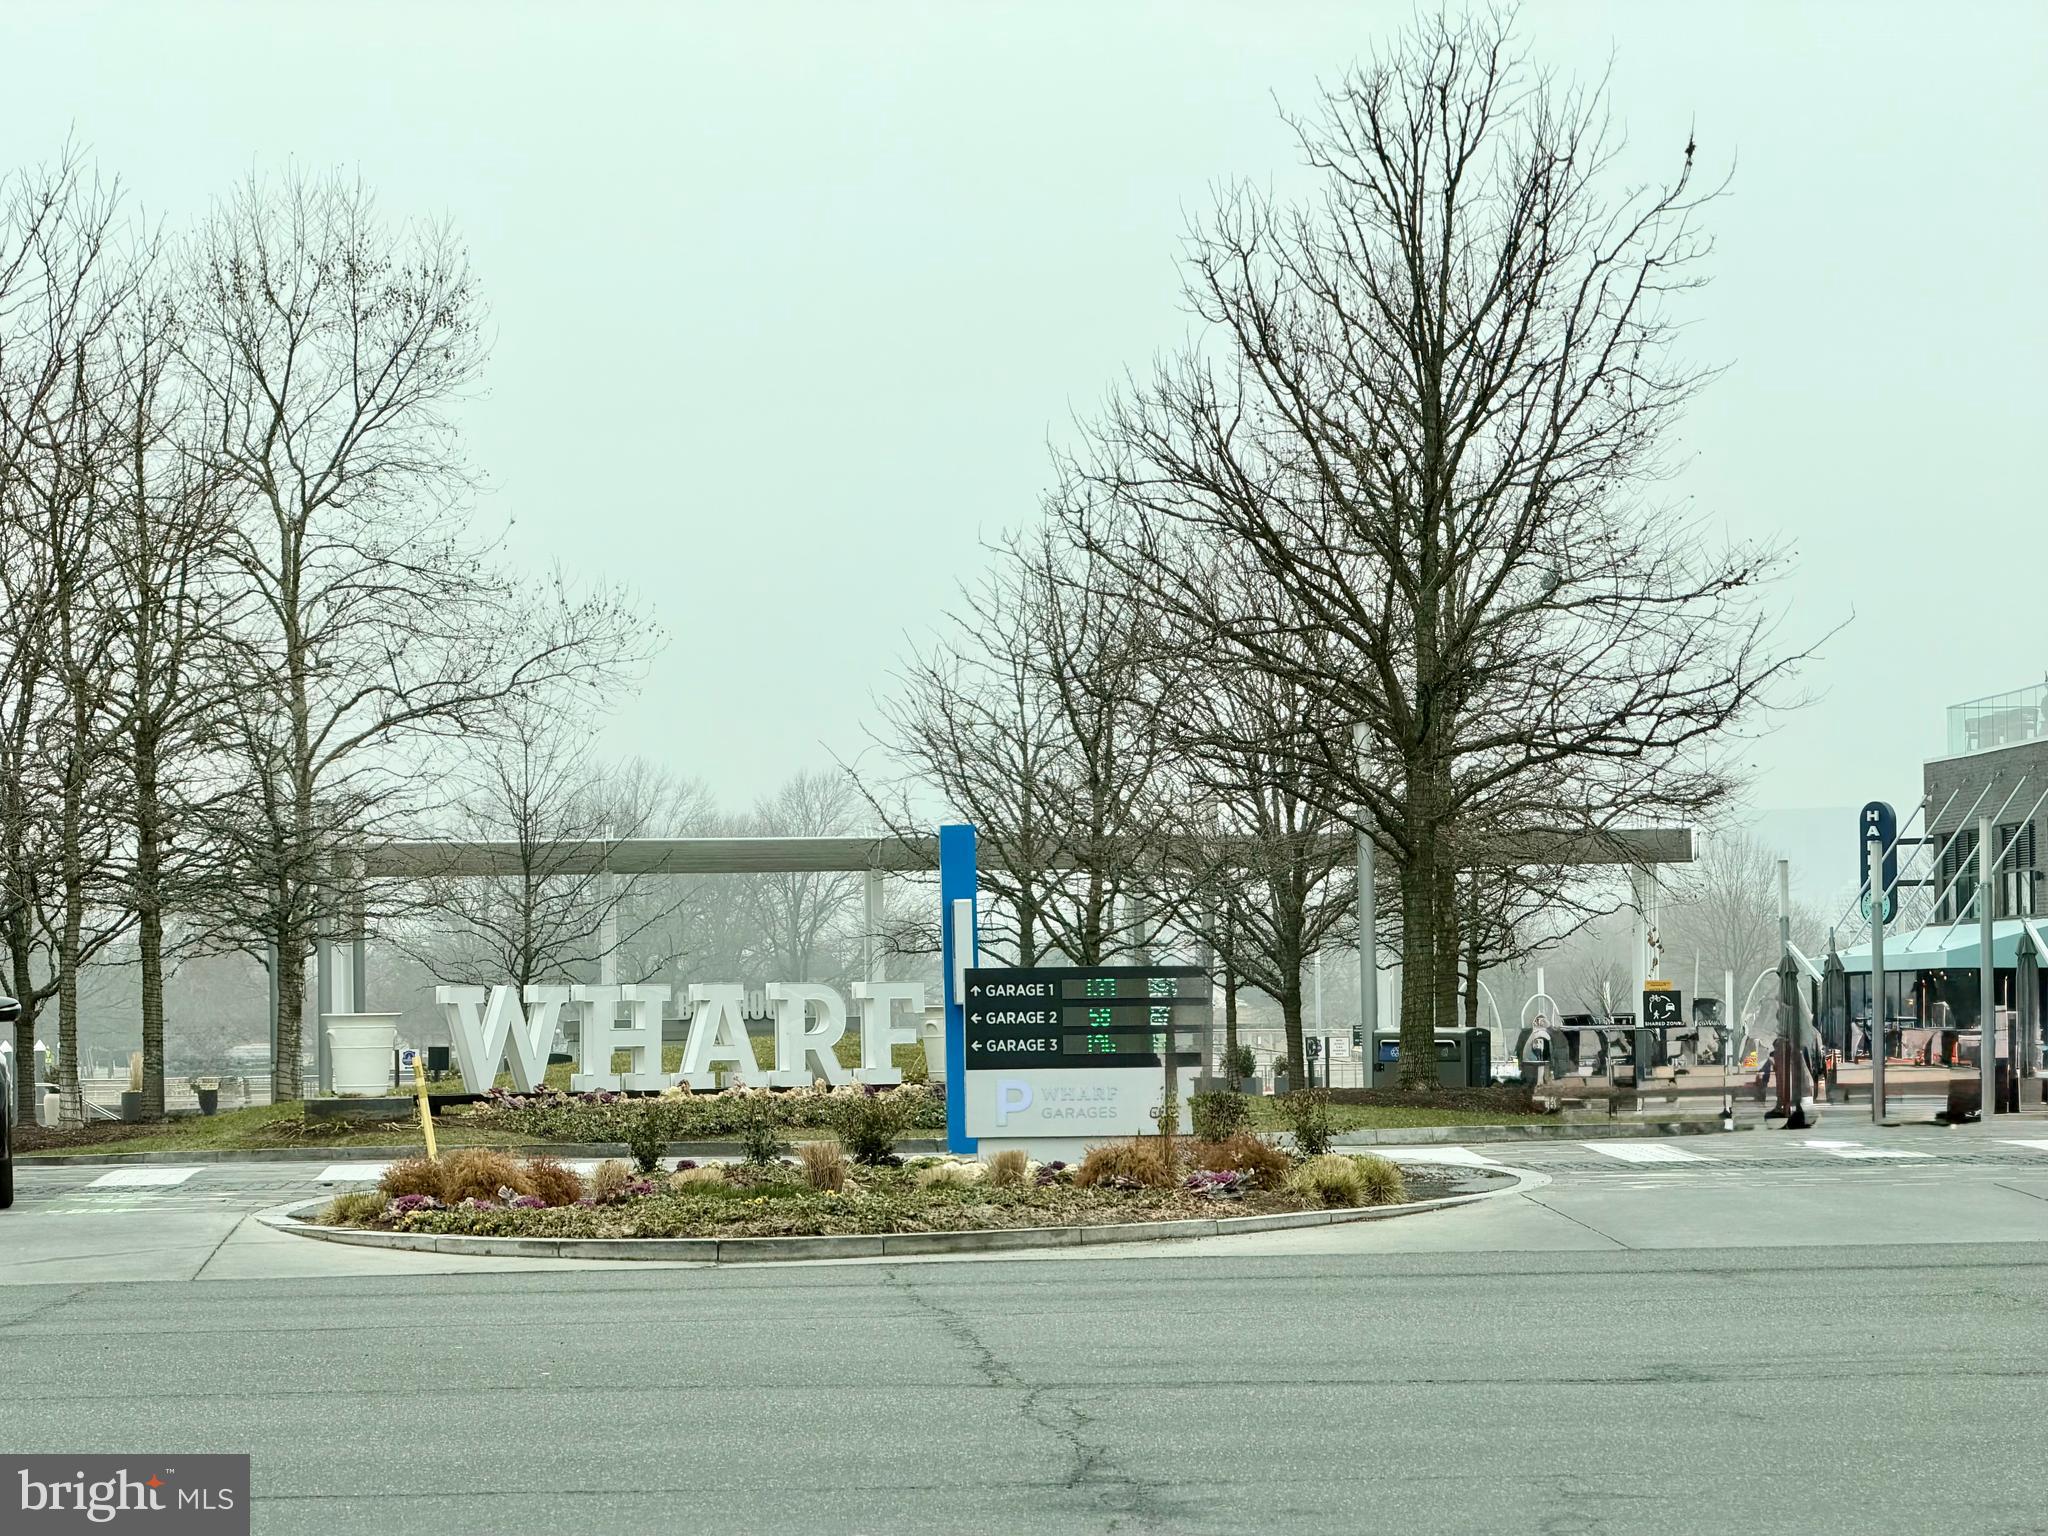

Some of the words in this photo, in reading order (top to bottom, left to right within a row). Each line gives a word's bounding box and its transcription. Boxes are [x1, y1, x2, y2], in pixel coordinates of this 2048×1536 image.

[985, 983, 1045, 997] GARAGE
[1048, 983, 1054, 996] 1
[986, 1011, 1045, 1024] GARAGE
[1048, 1011, 1058, 1024] 2
[435, 982, 924, 1093] WHARF
[986, 1038, 1046, 1052] GARAGE
[1049, 1038, 1058, 1051] 3
[1041, 1087, 1119, 1102] WHARF
[995, 1078, 1034, 1128] P
[1041, 1106, 1118, 1119] GARAGES
